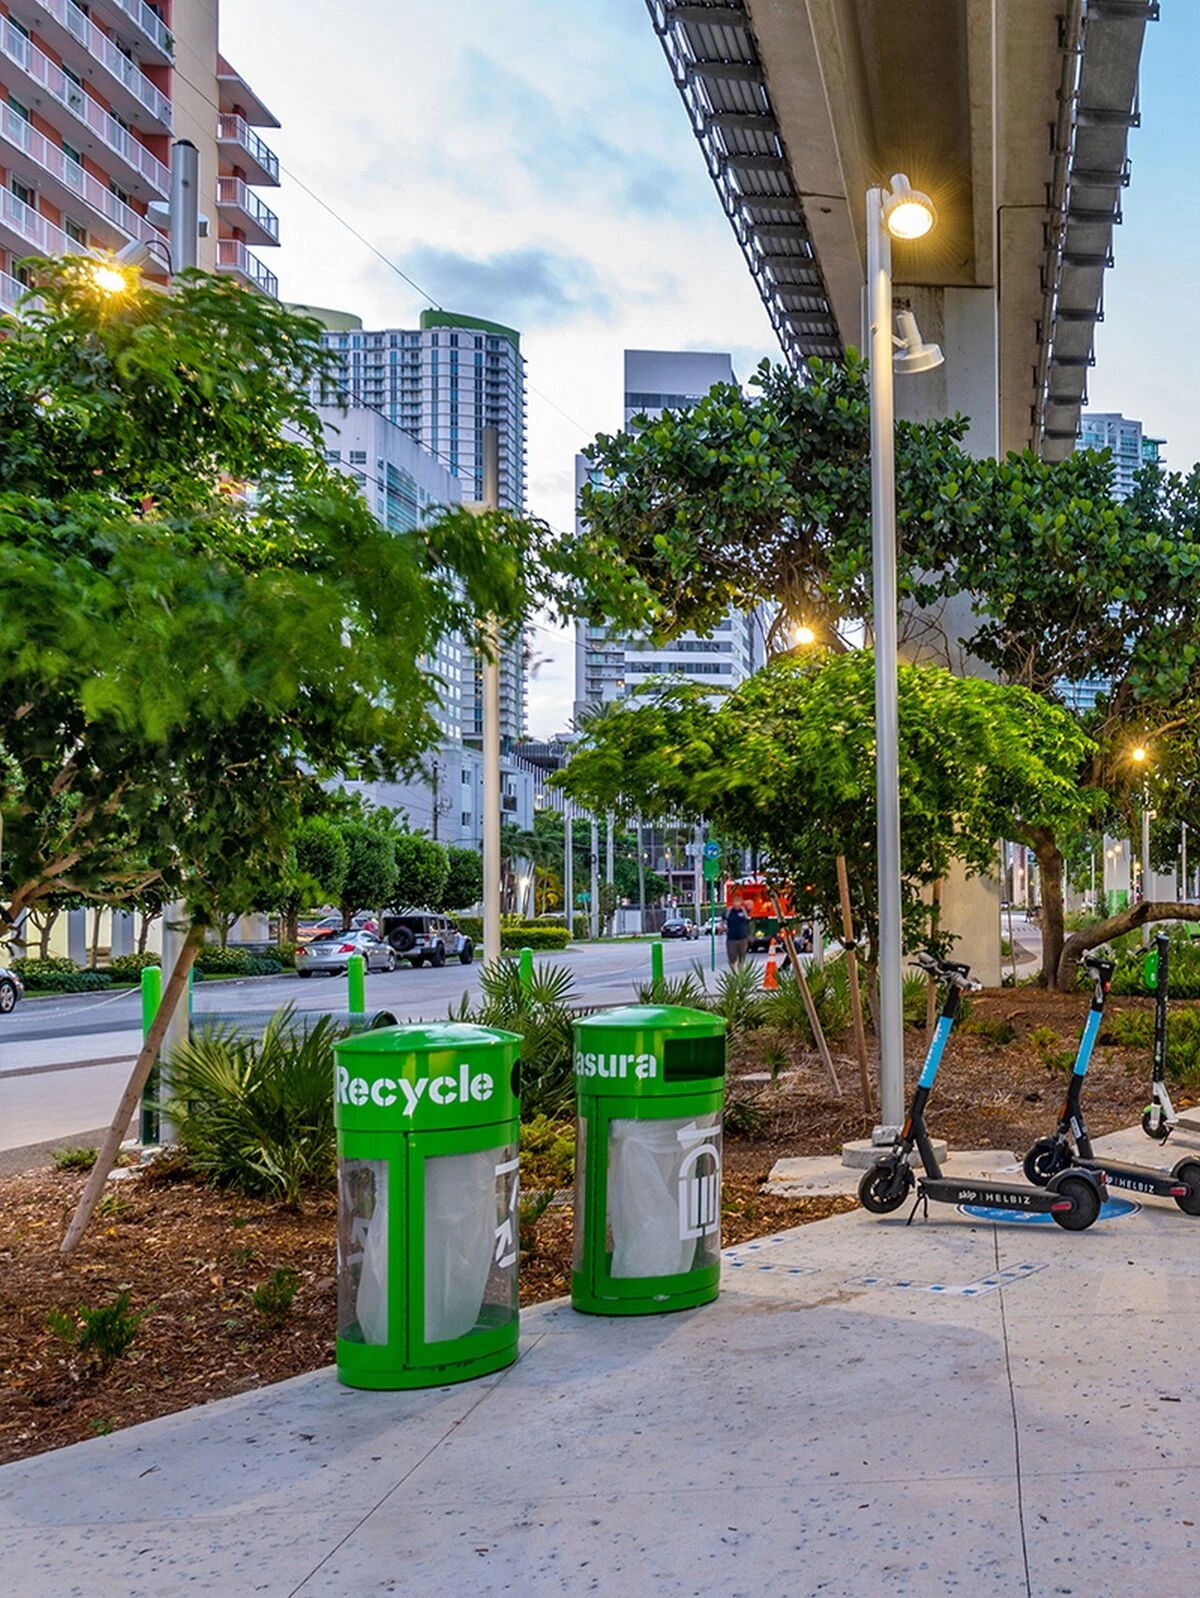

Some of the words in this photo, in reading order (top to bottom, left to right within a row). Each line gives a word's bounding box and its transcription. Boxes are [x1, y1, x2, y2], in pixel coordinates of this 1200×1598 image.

[573, 1044, 657, 1079] asura
[336, 1063, 494, 1117] Recycle
[985, 1192, 1031, 1205] HELBIZ
[1119, 1178, 1155, 1194] HELBIZ
